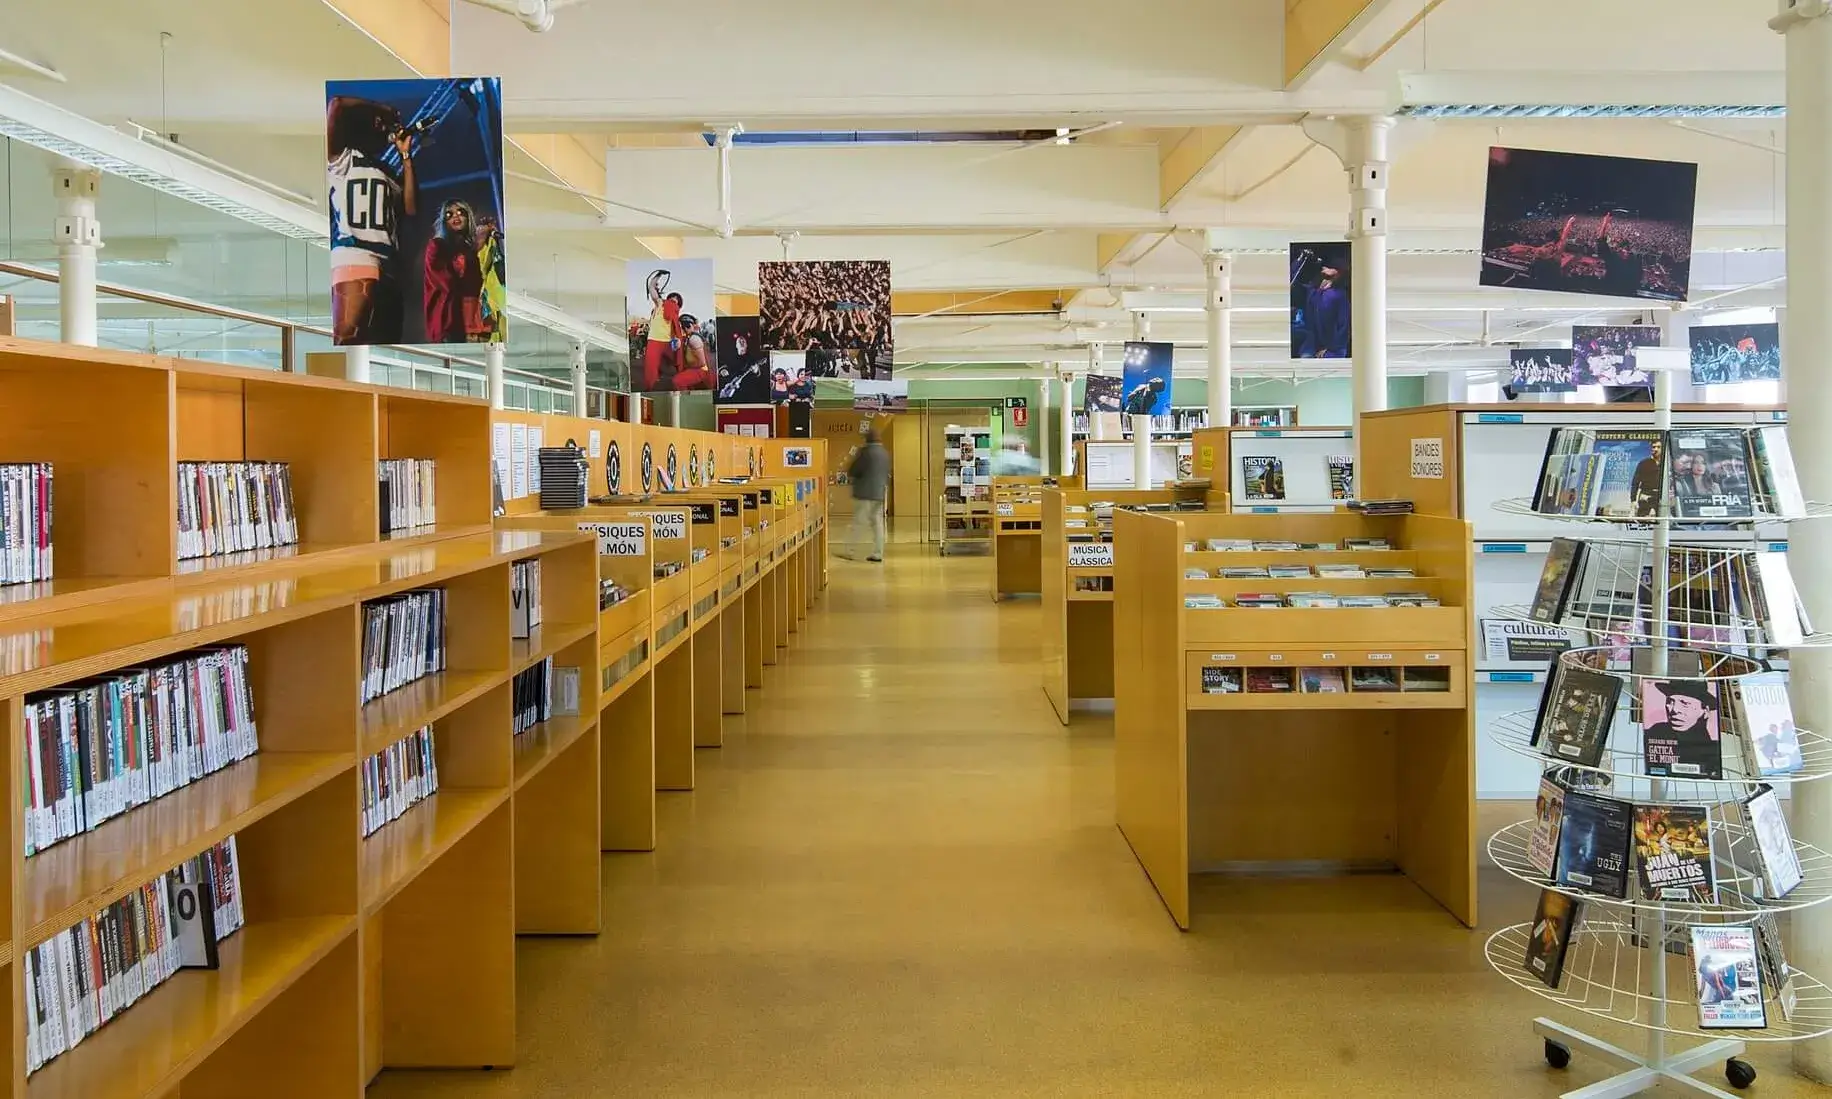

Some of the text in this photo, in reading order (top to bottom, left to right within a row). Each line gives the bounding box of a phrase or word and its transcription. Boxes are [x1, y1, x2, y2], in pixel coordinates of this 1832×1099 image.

[1415, 443, 1440, 457] BANDES
[1412, 462, 1443, 477] SONORES
[1712, 491, 1742, 506] FRÍA
[606, 541, 637, 554] MÓN
[1073, 543, 1108, 554] MÚSICA
[1648, 745, 1674, 755] GATICA
[1610, 852, 1622, 861] THE
[1645, 853, 1679, 870] JUAN
[1597, 857, 1622, 872] UGLY
[1647, 864, 1703, 883] MUERTOS
